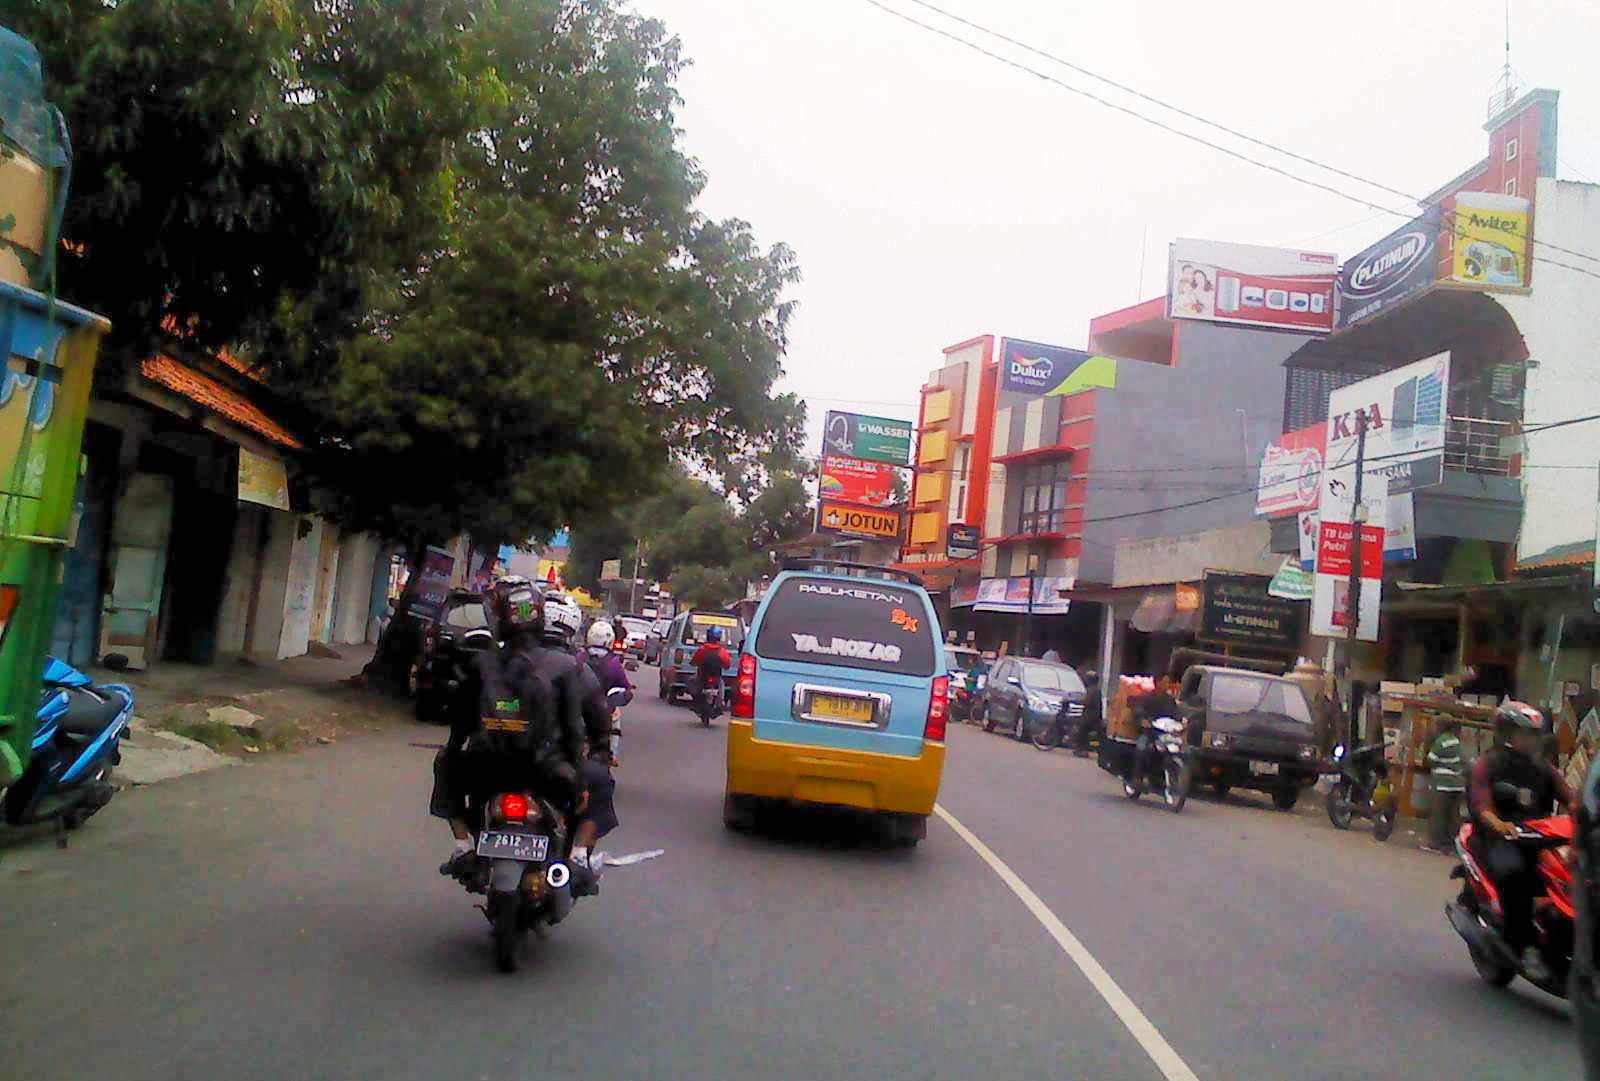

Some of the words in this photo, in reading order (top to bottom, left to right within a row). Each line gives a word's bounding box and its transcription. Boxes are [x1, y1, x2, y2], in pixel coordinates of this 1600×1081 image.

[1468, 213, 1518, 232] Avitex
[1357, 238, 1417, 286] PLATINUM
[1010, 361, 1048, 379] Dulux
[867, 424, 910, 439] WASSER
[842, 512, 895, 533] JOTUN
[1323, 541, 1346, 552] Putri
[799, 584, 904, 604] PASUKETAN
[481, 833, 489, 844] Z
[495, 834, 521, 848] 2612
